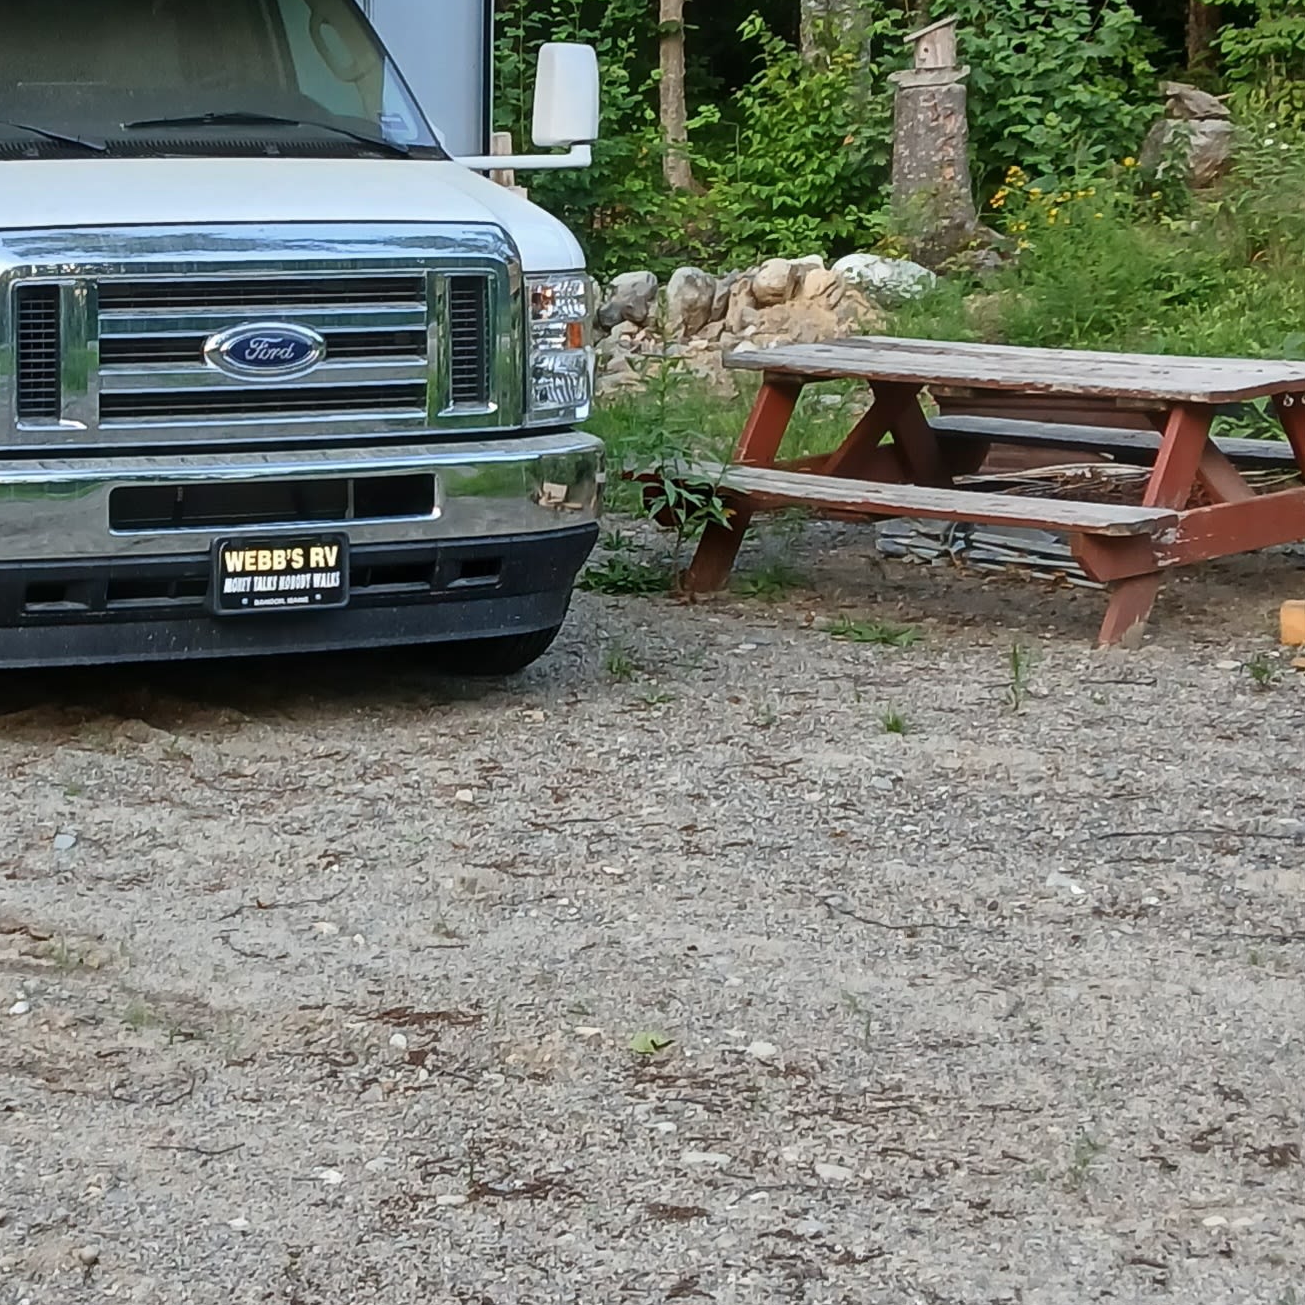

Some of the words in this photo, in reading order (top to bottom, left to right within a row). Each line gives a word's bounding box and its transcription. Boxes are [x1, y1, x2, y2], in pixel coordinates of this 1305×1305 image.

[245, 337, 295, 360] Ford
[225, 548, 304, 572] WEBB'S
[310, 545, 339, 568] RV
[223, 576, 252, 593] MONEY
[253, 575, 278, 592] TALKS
[278, 573, 312, 591] NOBODY
[313, 571, 341, 588] WALKS
